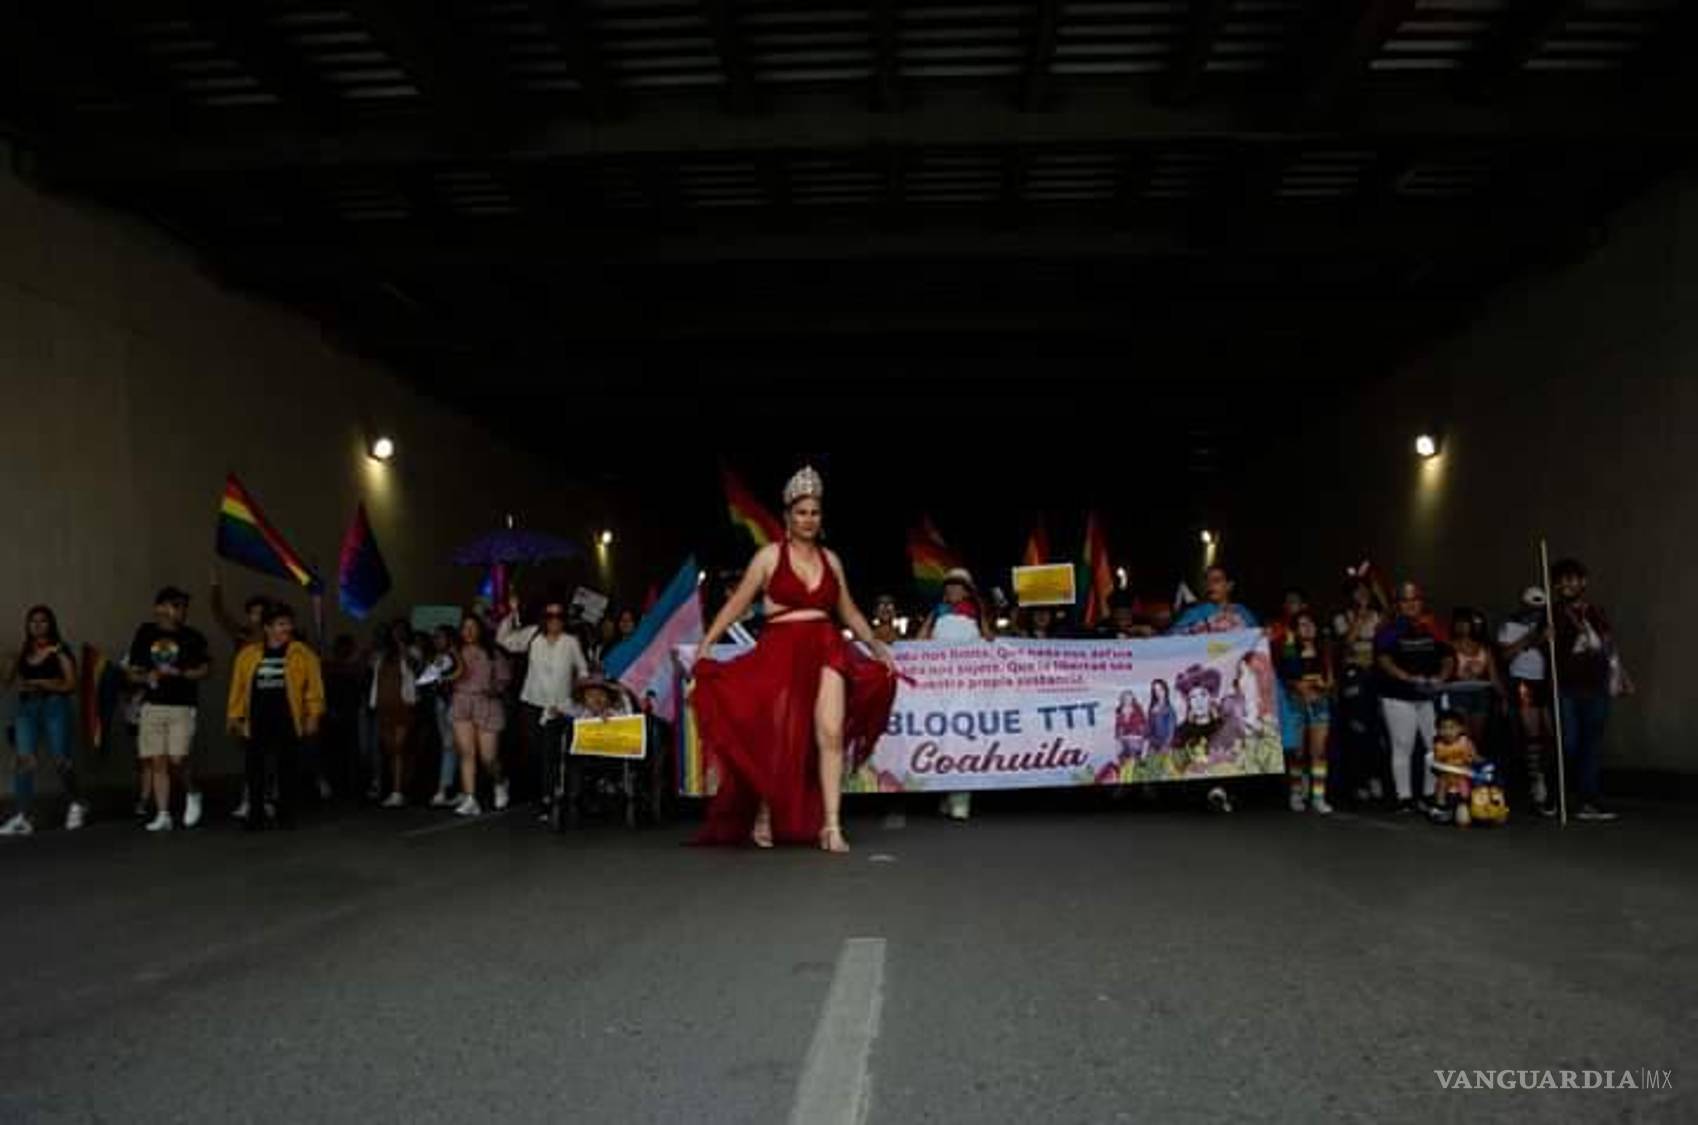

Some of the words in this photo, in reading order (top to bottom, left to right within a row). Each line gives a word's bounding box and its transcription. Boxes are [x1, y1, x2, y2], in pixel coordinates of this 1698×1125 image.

[886, 709, 1022, 740] BLOQUE
[1037, 702, 1099, 731] TTT
[910, 736, 1088, 774] Coahuila
